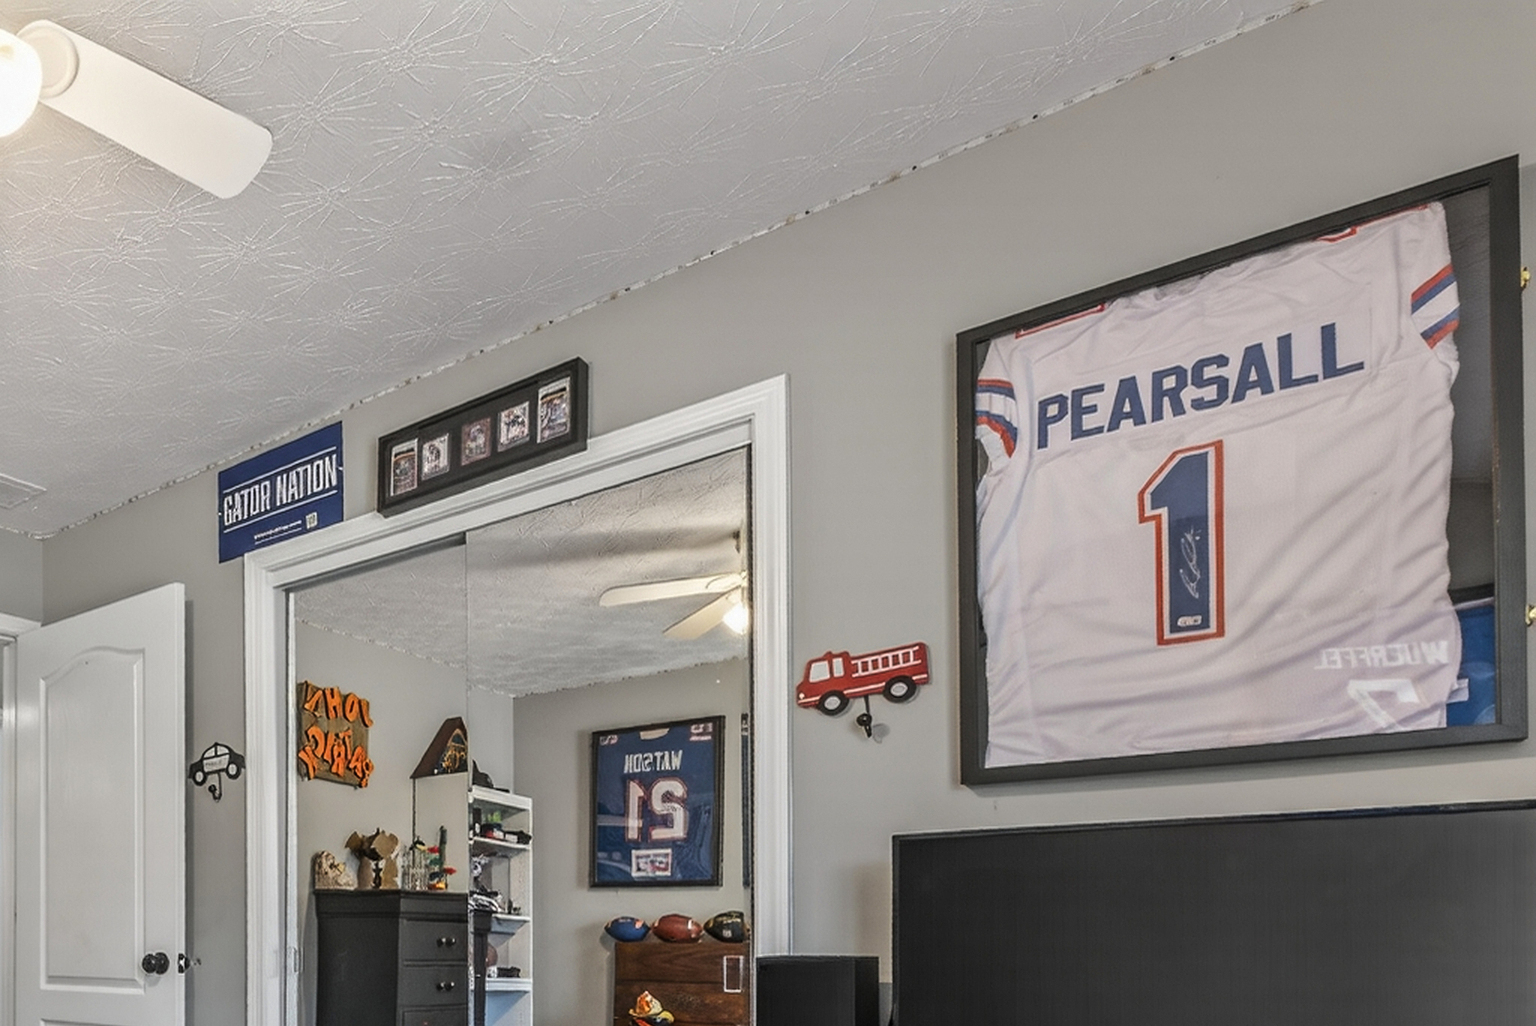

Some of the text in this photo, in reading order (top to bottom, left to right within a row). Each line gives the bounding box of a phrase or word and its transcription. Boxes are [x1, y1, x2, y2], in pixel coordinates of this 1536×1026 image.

[1037, 322, 1365, 450] PEARSALL
[223, 454, 338, 527] GATOR NATION
[1138, 440, 1225, 646] 1
